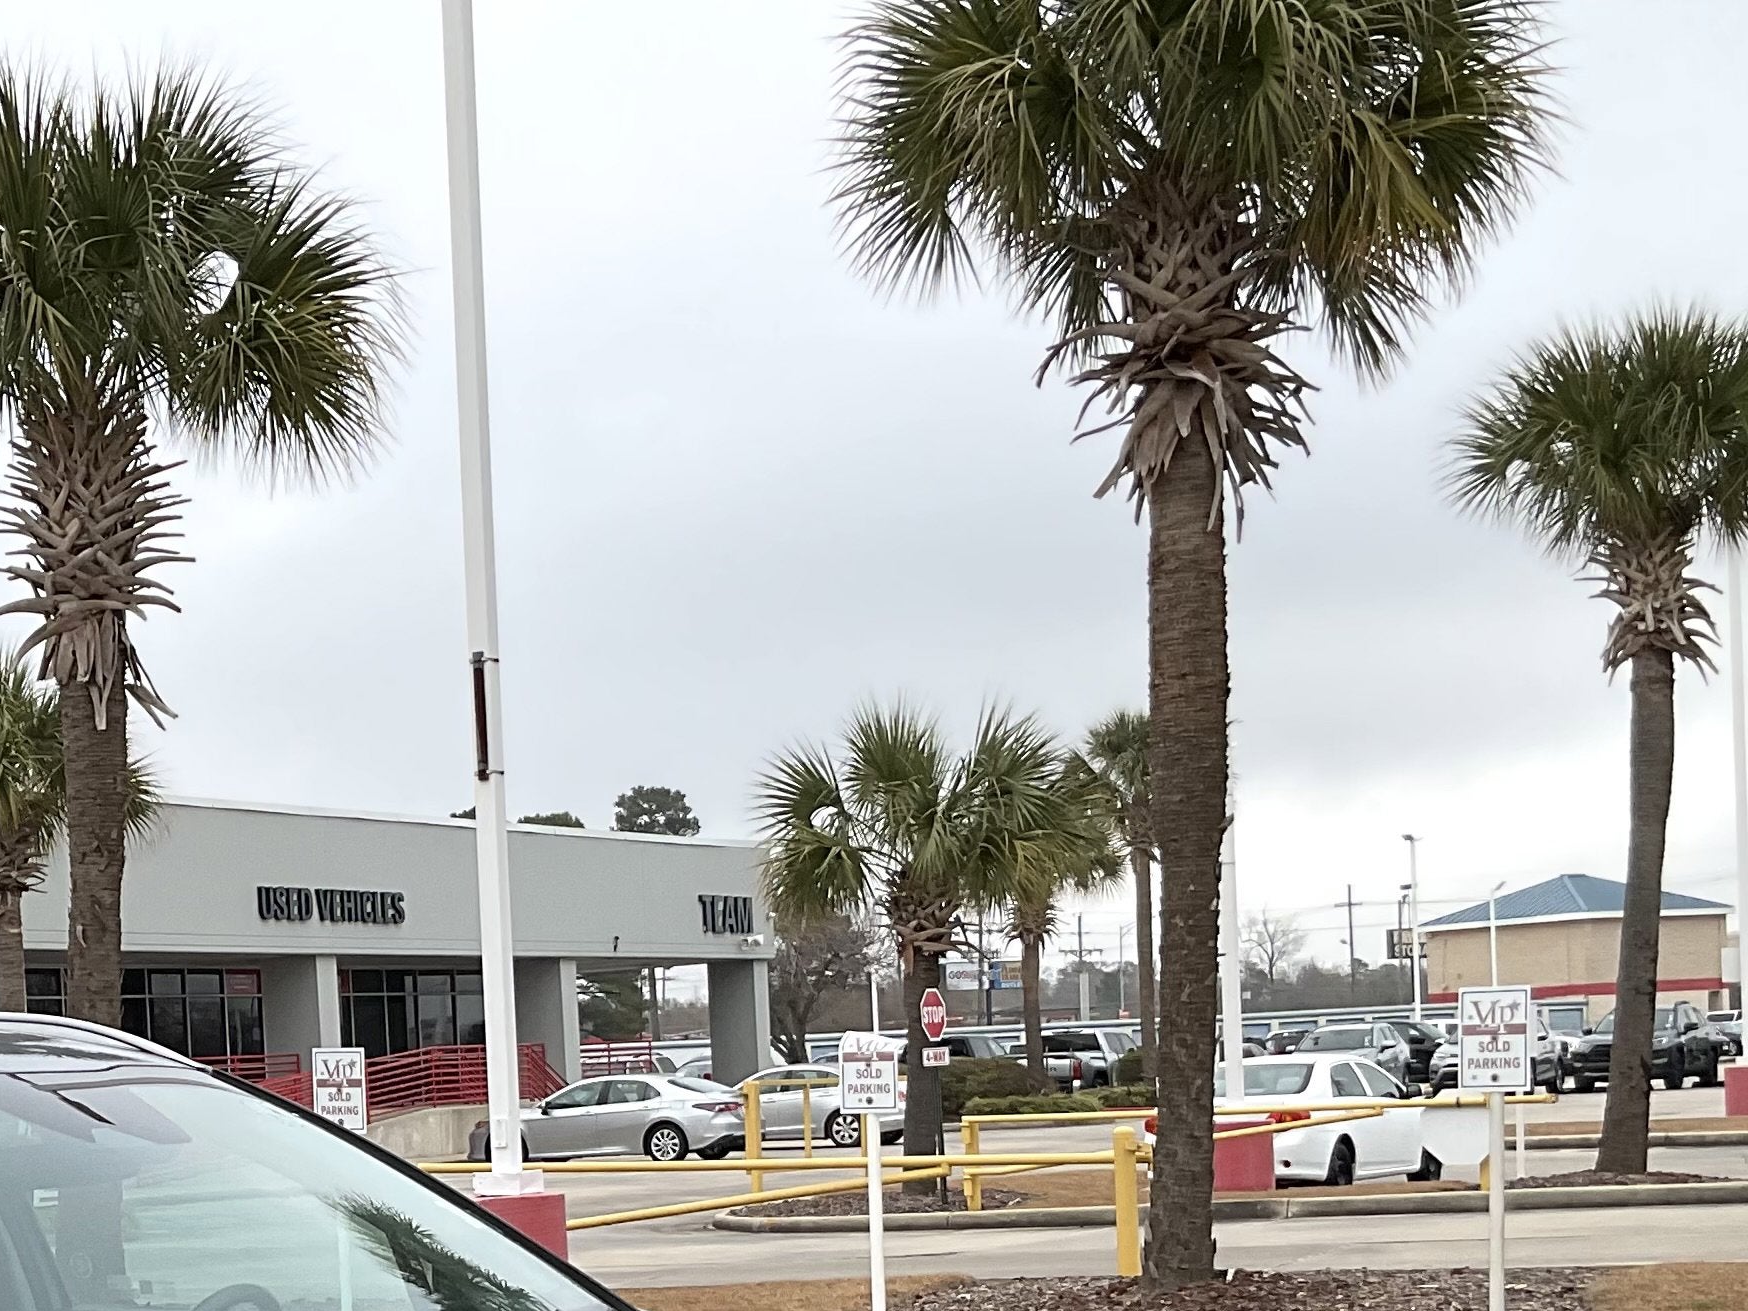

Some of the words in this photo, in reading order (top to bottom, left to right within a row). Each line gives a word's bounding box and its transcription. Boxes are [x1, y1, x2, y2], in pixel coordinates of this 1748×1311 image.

[257, 886, 313, 921] USED
[314, 888, 406, 924] VEHICLES
[698, 894, 754, 934] TEAM
[922, 1006, 944, 1024] STOP
[1478, 1041, 1511, 1052] SOLD
[925, 1051, 946, 1062] 4-WAY
[1467, 1057, 1521, 1069] PARKING
[855, 1069, 882, 1079] SOLD
[847, 1083, 891, 1094] PARKING
[328, 1091, 352, 1102] SOLD
[320, 1106, 359, 1116] PARKING
